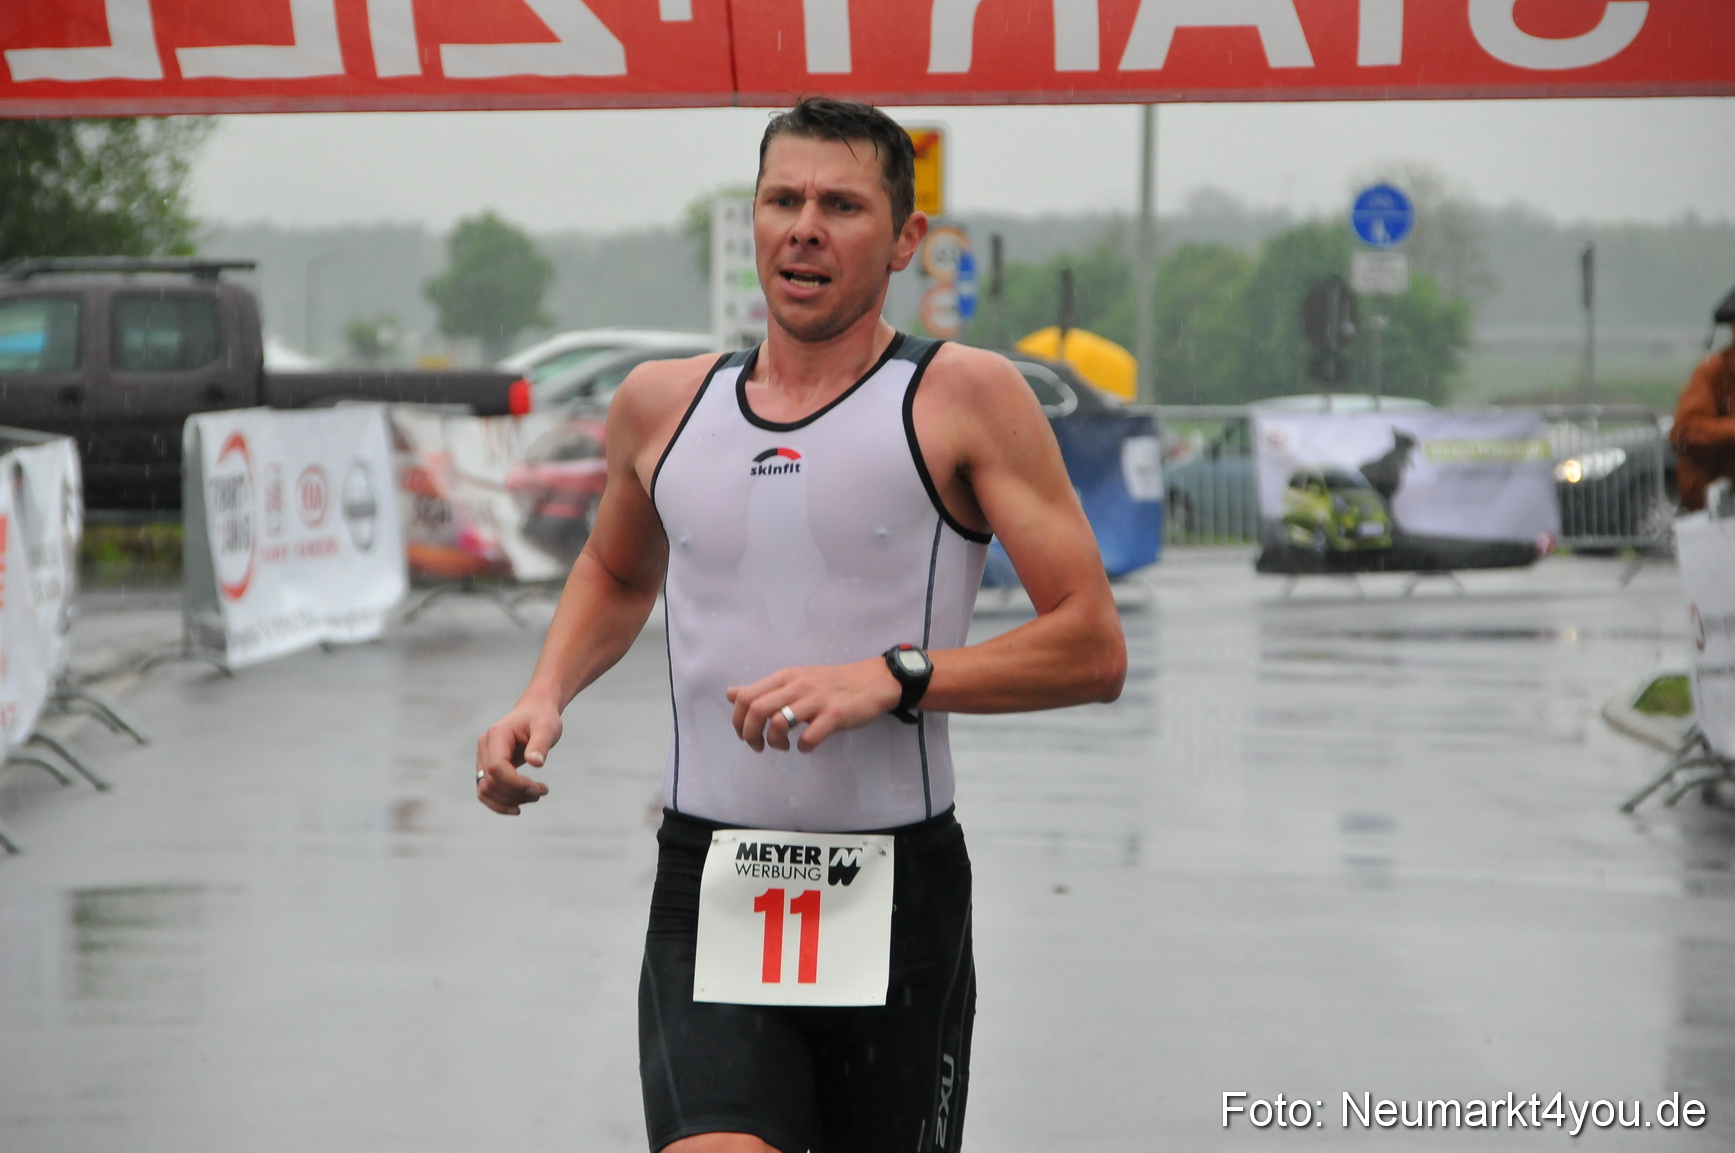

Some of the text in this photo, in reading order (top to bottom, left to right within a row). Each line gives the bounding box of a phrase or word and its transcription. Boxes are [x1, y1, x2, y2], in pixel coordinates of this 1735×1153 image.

[750, 462, 801, 476] skinfit
[735, 842, 822, 866] MEYER
[735, 863, 822, 881] WERBUNG
[754, 888, 821, 984] 11
[935, 1053, 954, 1149] 2XU
